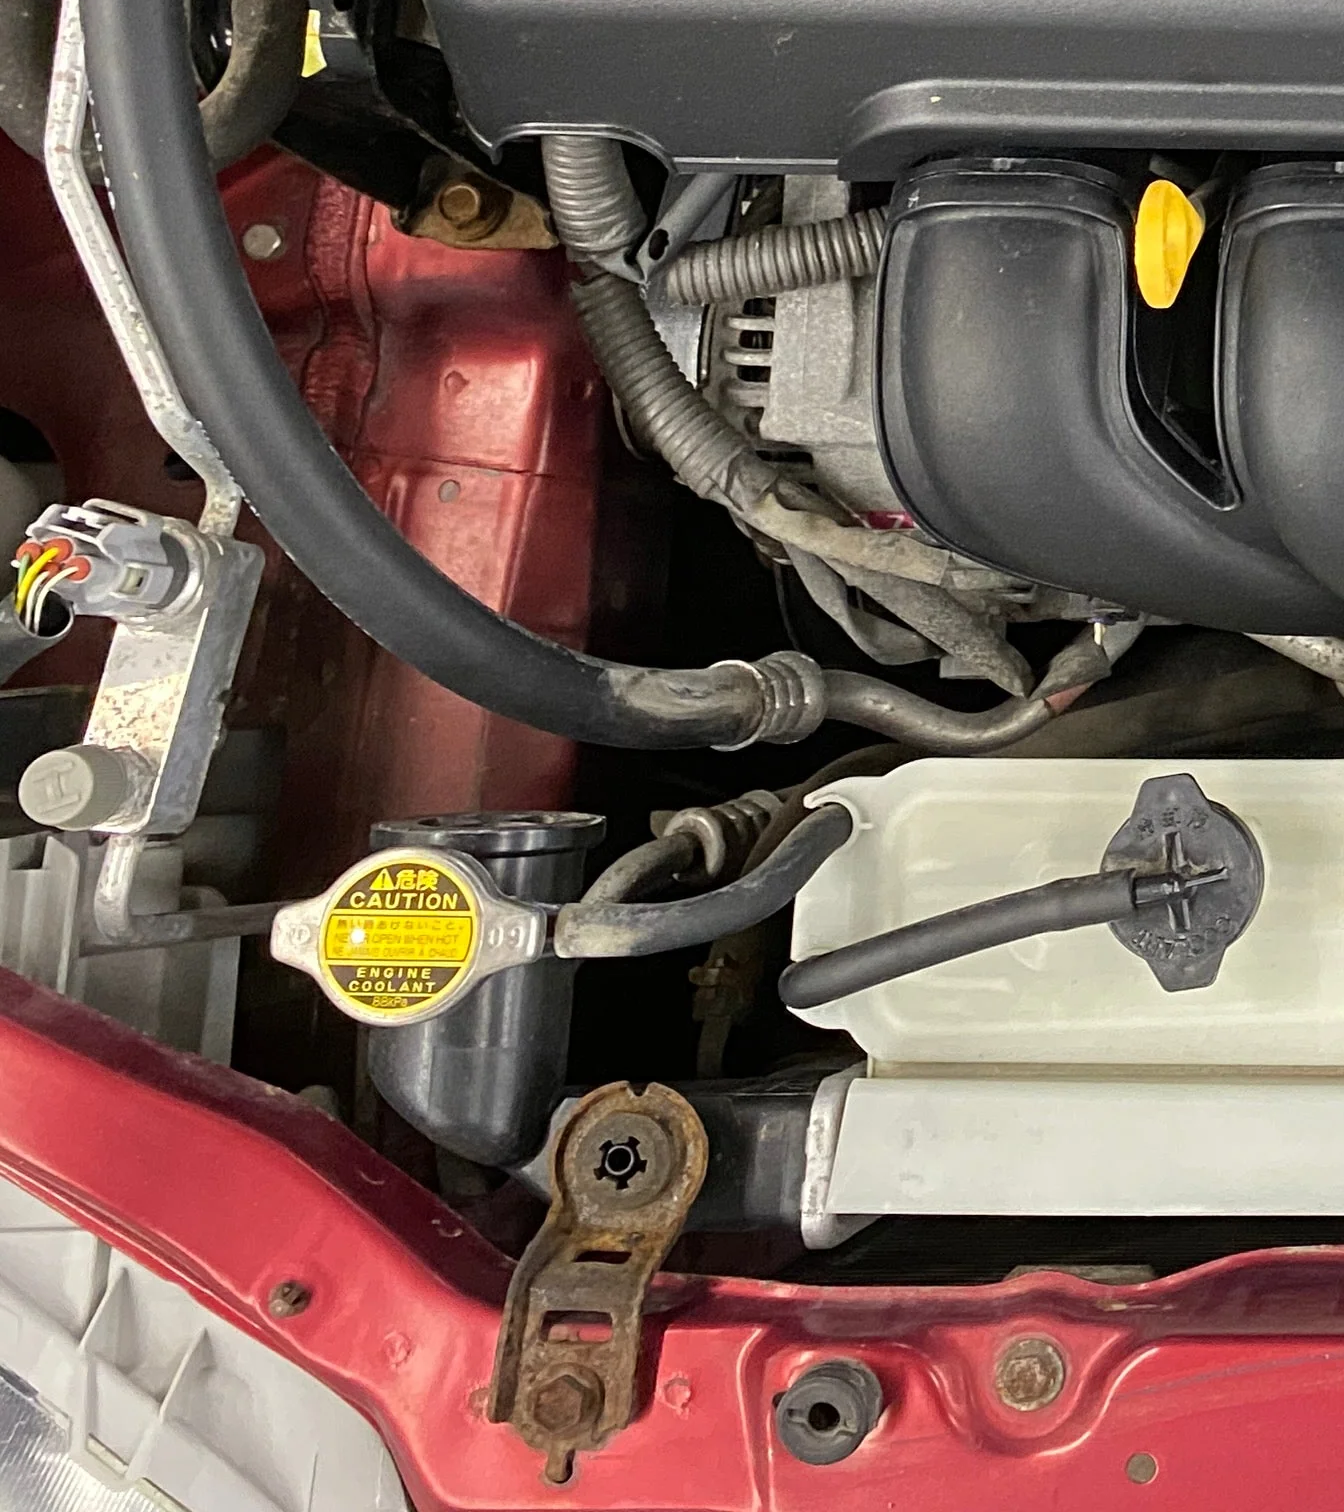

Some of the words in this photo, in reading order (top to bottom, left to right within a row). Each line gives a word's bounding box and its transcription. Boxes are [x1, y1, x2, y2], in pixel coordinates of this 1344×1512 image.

[395, 869, 438, 891] 危険
[349, 891, 459, 910] CAUTION
[334, 933, 371, 944] NER
[371, 933, 402, 945] OPEN
[403, 934, 435, 945] WHEN
[435, 935, 460, 945] HOT
[356, 967, 432, 980] ENGINE
[348, 981, 436, 993] COOLANT
